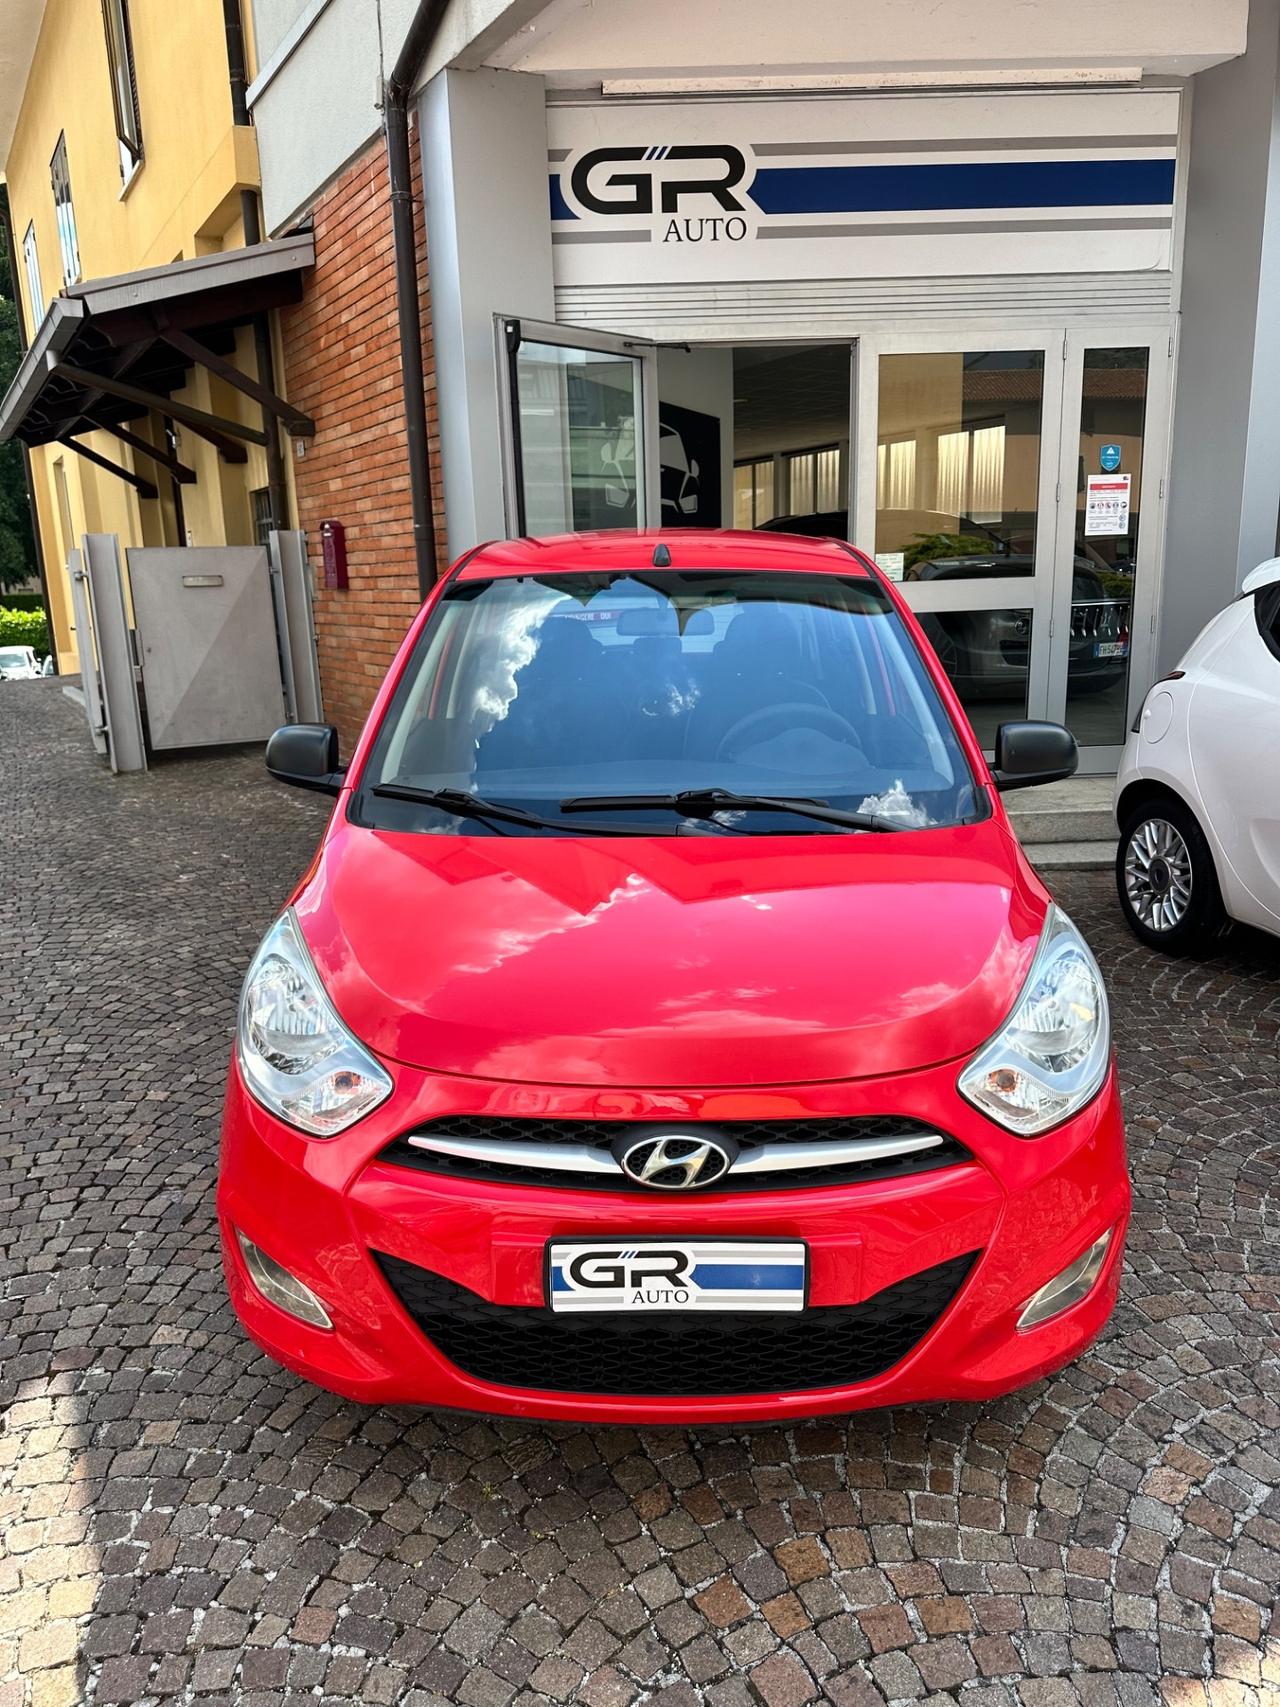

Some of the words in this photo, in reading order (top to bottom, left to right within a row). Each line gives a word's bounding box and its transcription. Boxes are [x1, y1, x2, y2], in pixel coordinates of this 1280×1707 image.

[571, 145, 746, 215] GR
[662, 217, 747, 242] AUTO
[569, 1250, 689, 1288] GR
[631, 1289, 689, 1304] AUTO
